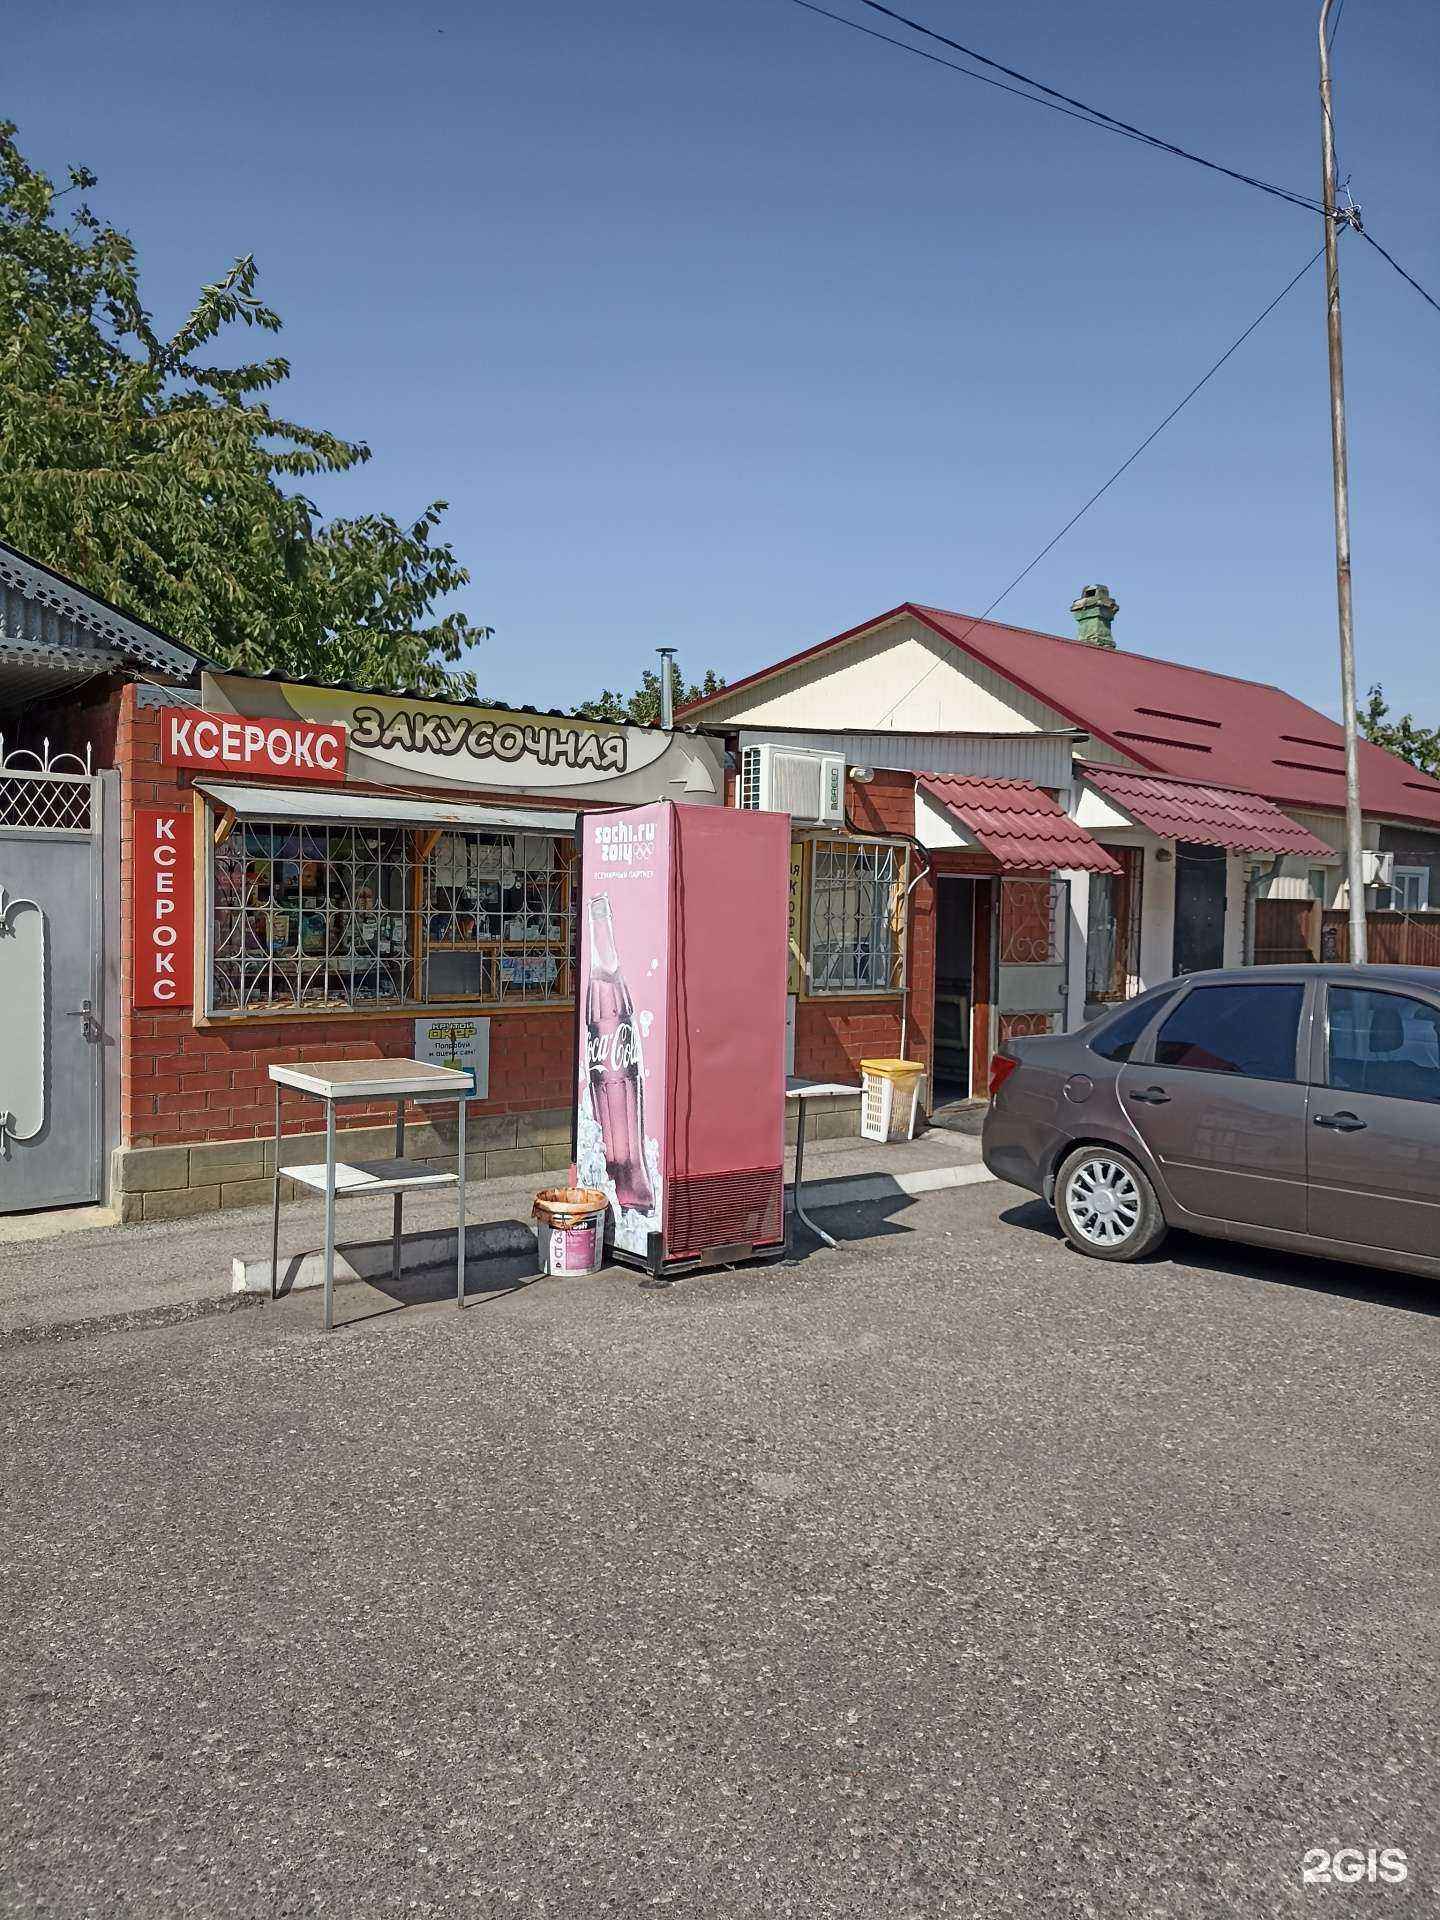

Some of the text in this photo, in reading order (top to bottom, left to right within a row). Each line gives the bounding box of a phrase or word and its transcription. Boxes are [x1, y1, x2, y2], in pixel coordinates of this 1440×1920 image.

[171, 717, 338, 769] КСЕРОКС
[351, 706, 627, 773] ЗАКУСОЧНАЯ
[595, 820, 655, 844] sochi.ru
[602, 843, 632, 865] 2014
[153, 818, 177, 1000] КСЕРОКС
